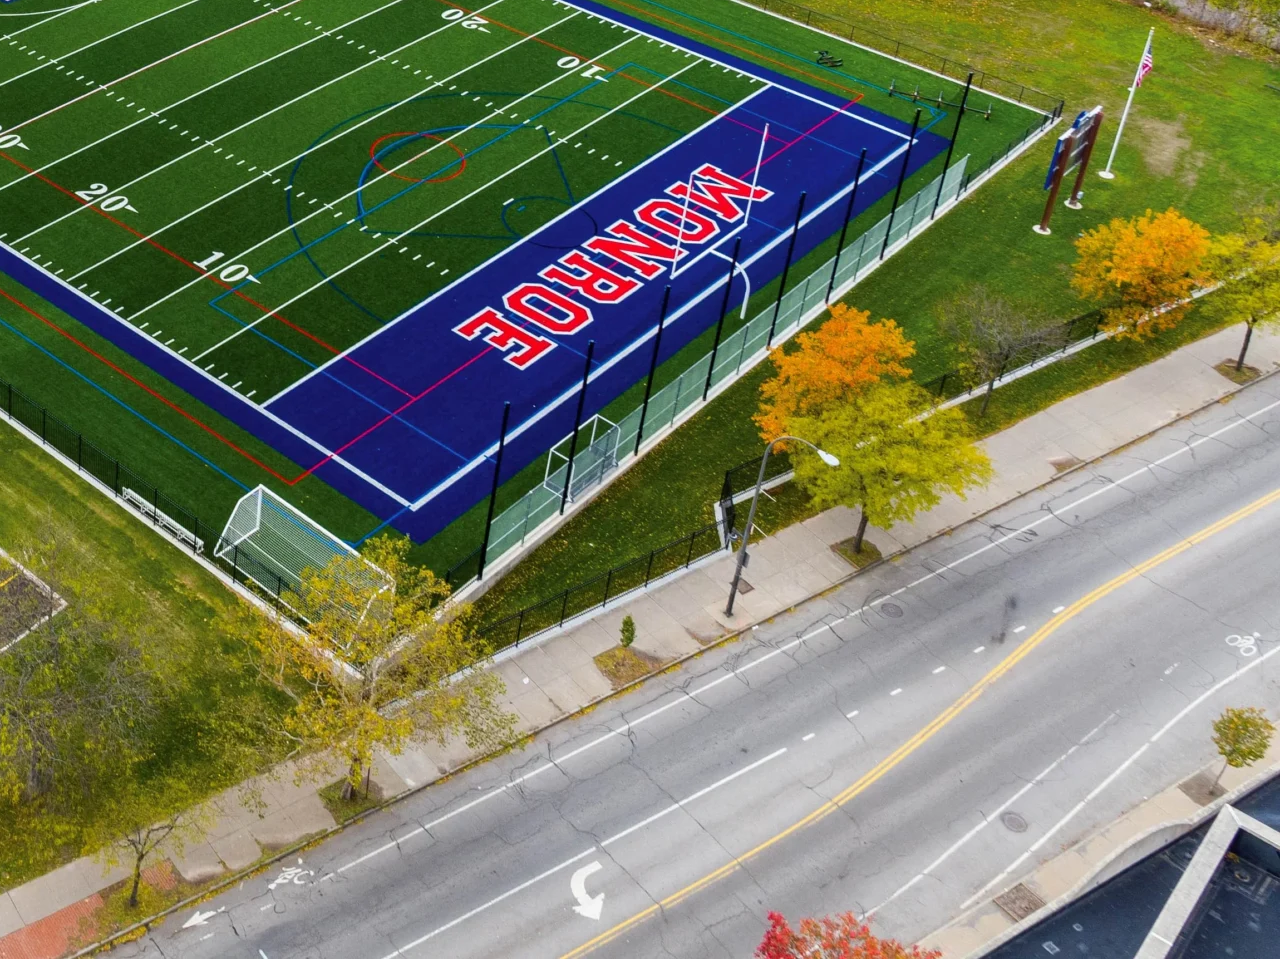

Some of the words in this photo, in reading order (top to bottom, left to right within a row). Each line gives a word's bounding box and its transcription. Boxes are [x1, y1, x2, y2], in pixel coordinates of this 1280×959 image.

[441, 8, 489, 30] 20
[557, 56, 606, 78] 10
[75, 183, 129, 212] 20
[193, 250, 249, 282] 10
[451, 163, 775, 371] MONROE
